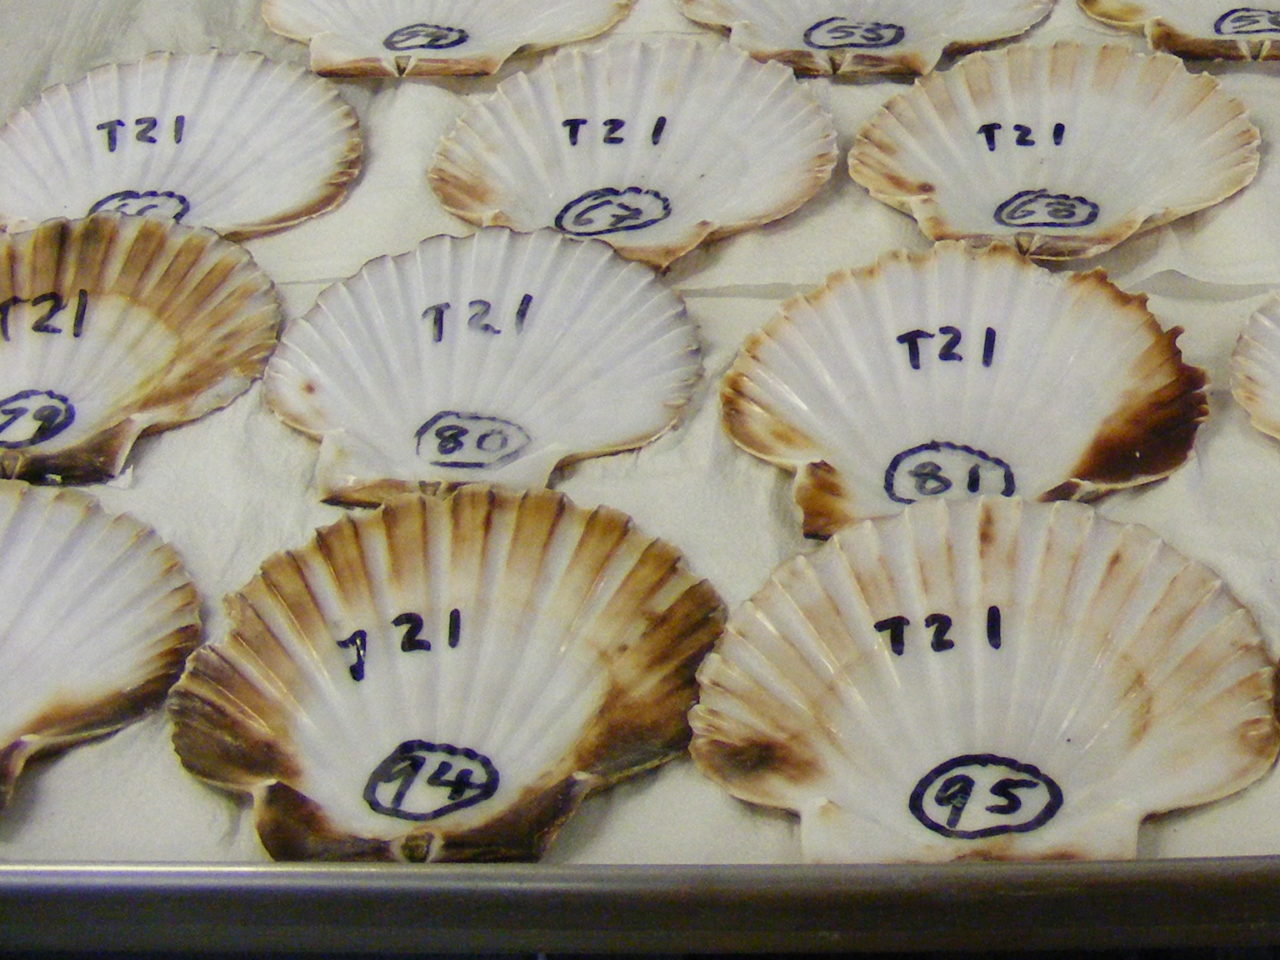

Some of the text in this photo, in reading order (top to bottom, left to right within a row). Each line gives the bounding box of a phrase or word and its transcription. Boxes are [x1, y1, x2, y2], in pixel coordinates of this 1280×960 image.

[95, 114, 186, 153] T21
[561, 115, 668, 147] T21
[976, 121, 1066, 152] T21
[420, 293, 534, 343] T21
[896, 325, 998, 370] T21
[873, 604, 1003, 657] T21
